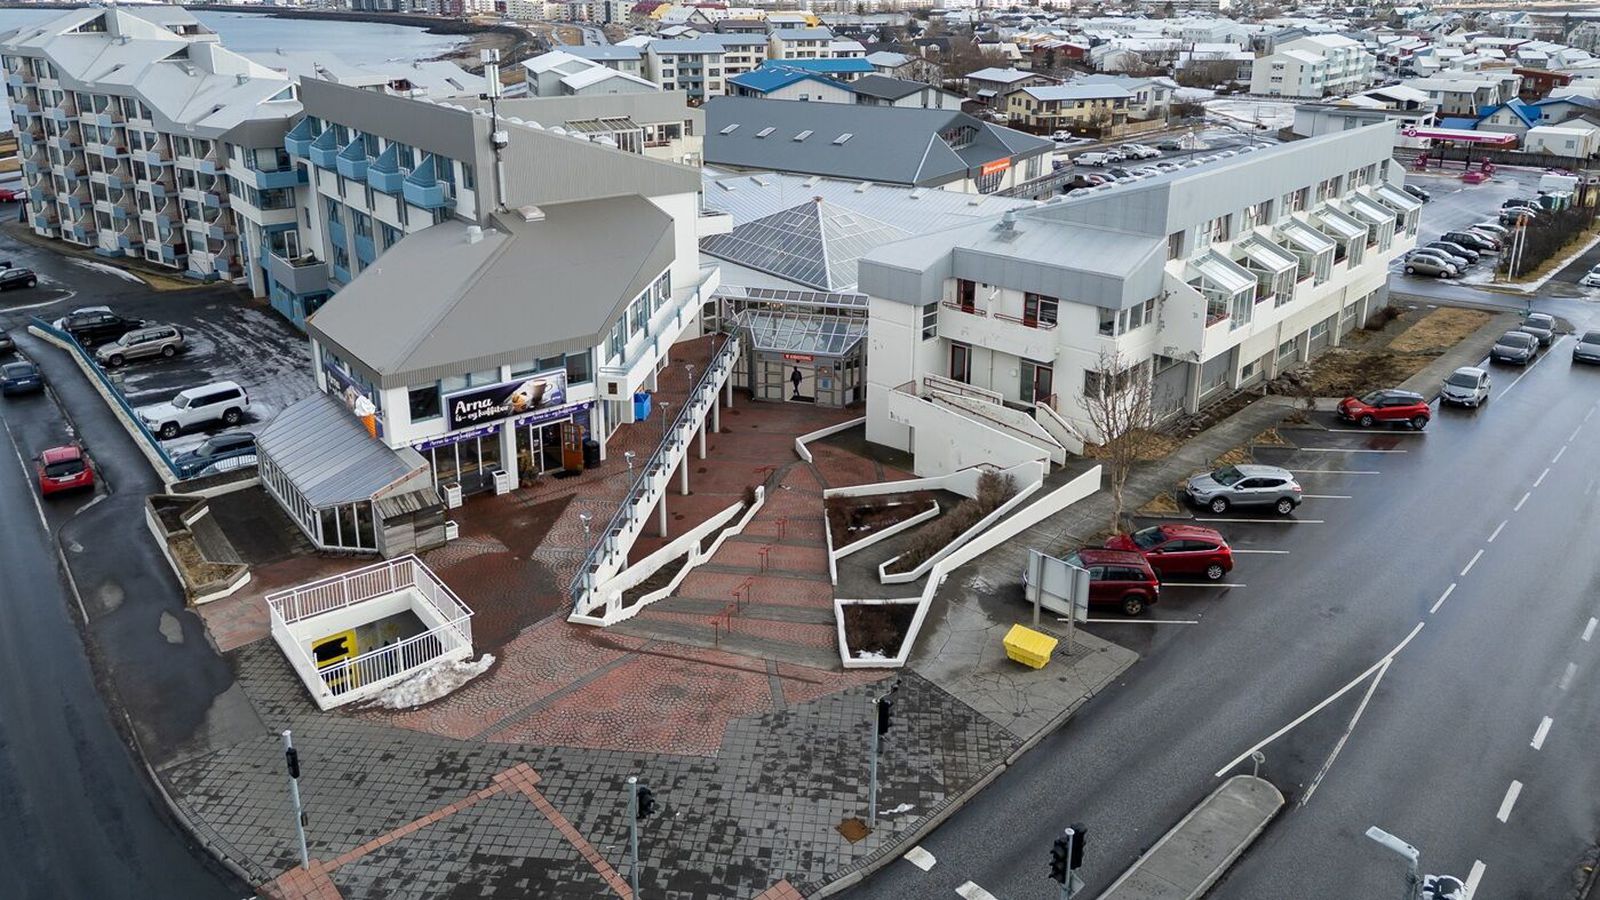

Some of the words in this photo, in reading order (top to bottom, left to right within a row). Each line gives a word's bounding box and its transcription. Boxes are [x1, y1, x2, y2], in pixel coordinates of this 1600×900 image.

[455, 398, 492, 413] Arna
[467, 411, 478, 421] og
[478, 405, 509, 417] kaffibar
